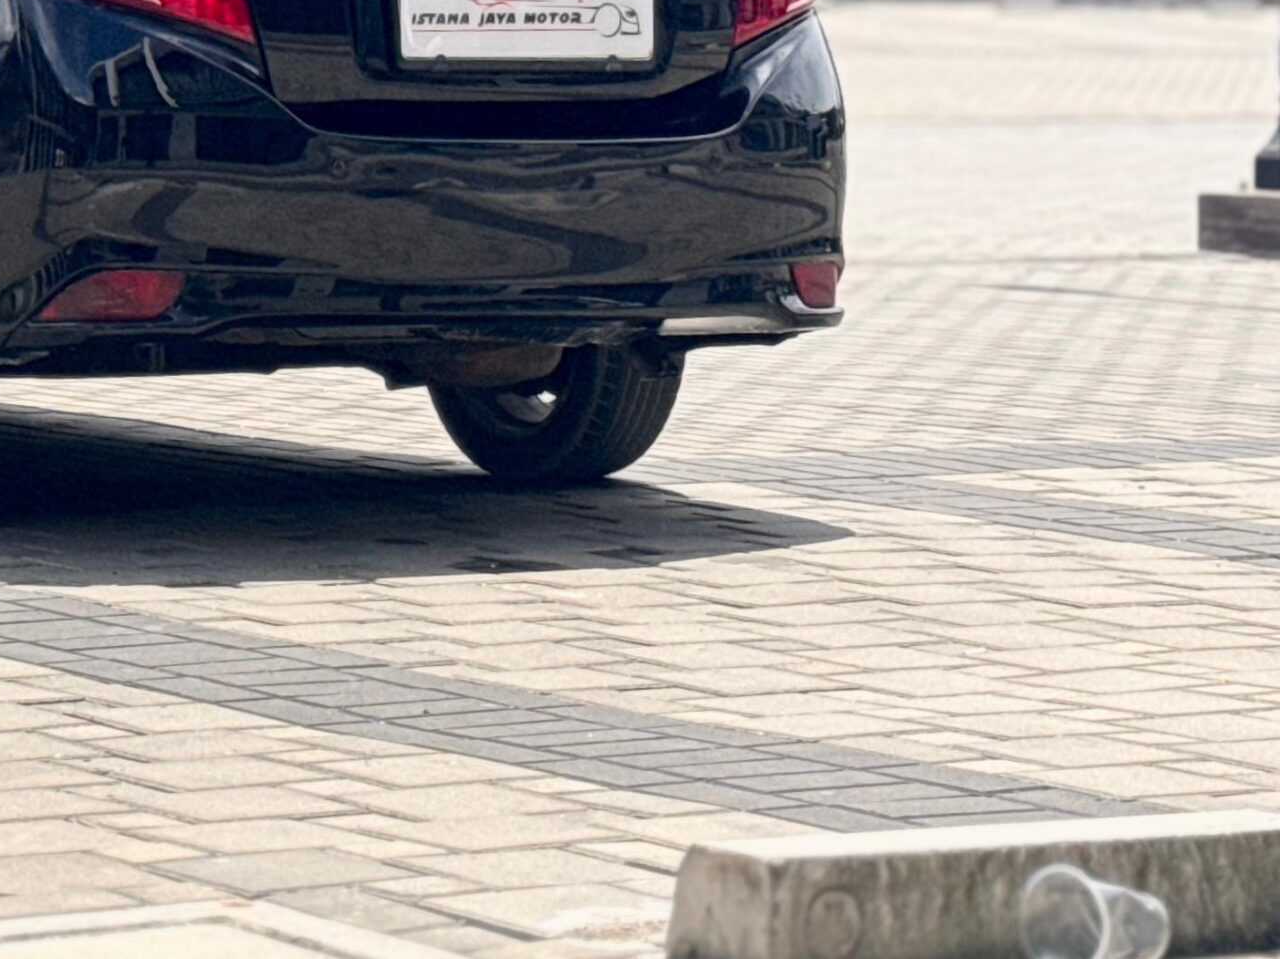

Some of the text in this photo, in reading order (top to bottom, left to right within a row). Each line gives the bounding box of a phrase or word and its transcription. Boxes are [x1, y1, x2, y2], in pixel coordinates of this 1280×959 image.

[411, 11, 582, 28] ISTANA JAYA MOTOR
